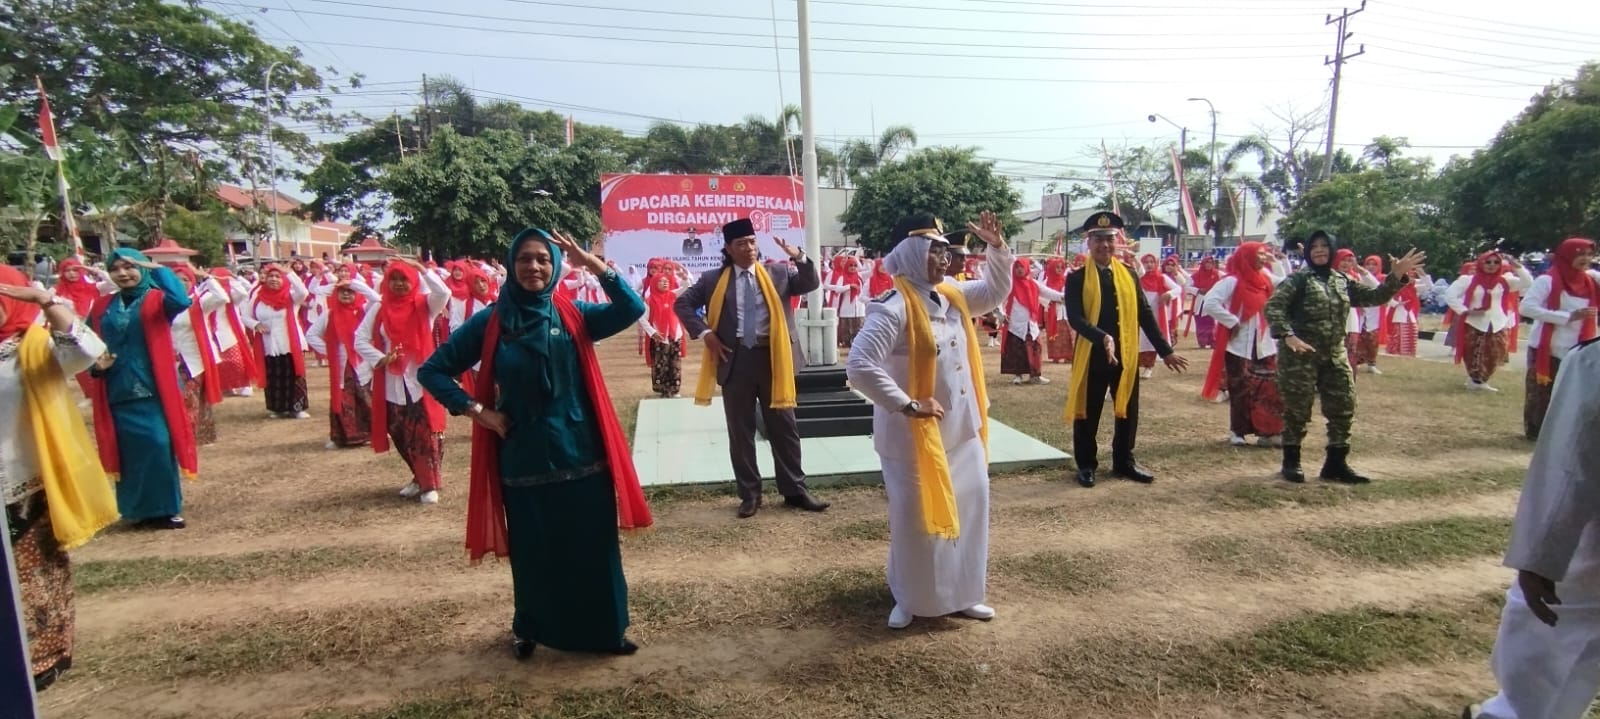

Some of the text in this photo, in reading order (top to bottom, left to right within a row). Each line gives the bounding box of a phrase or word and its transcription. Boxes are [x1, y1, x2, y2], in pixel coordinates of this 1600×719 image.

[618, 194, 804, 213] UPACARA KEMERDEKAAN
[647, 212, 738, 225] DIRGAHAYU
